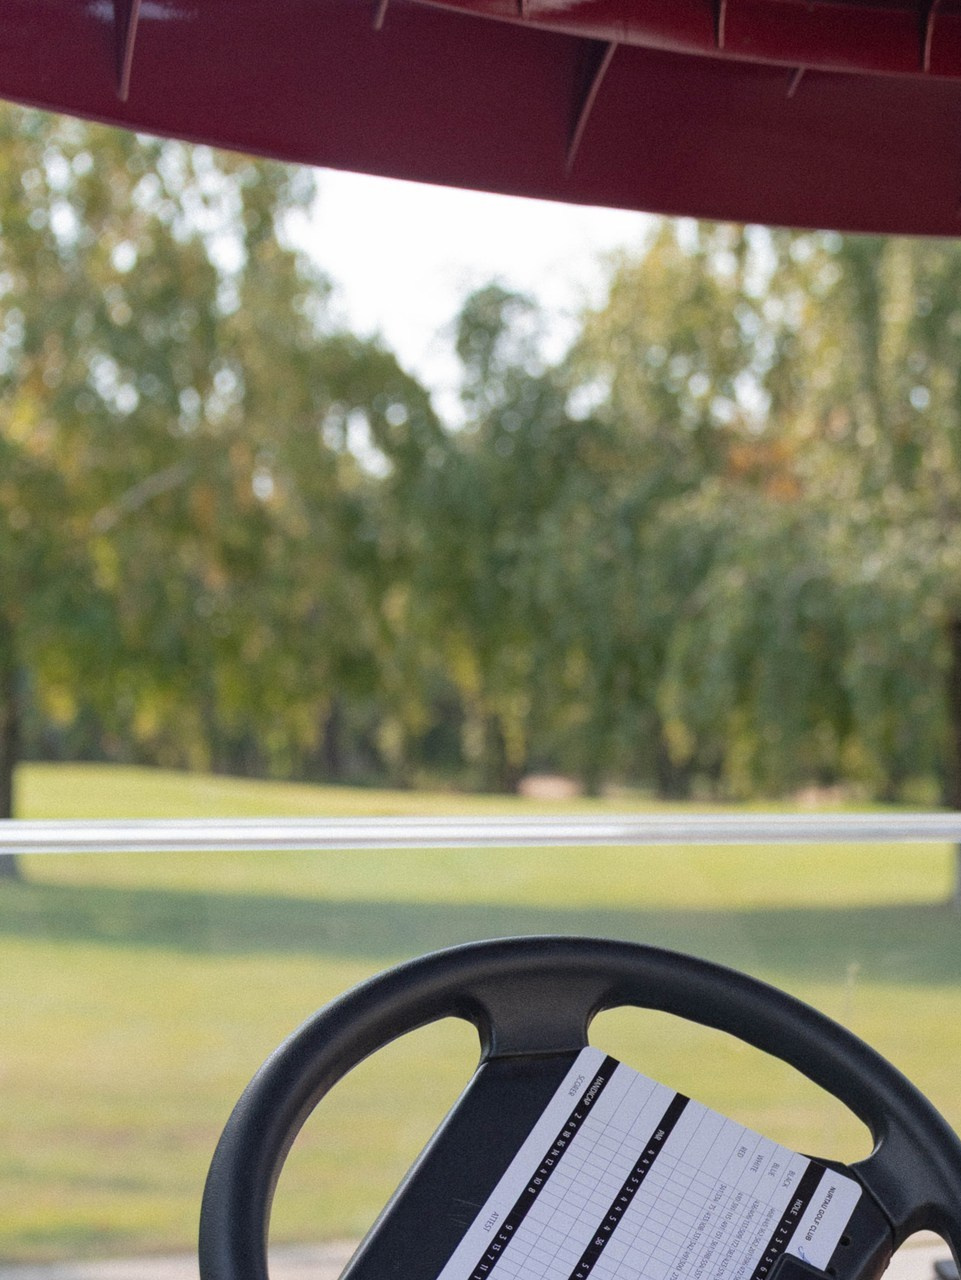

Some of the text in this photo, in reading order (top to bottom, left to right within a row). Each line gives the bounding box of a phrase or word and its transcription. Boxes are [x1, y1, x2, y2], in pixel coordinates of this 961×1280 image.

[567, 1074, 585, 1097] SCORER
[582, 1075, 604, 1105] HANDICAP
[561, 1129, 571, 1138] 18
[653, 1129, 664, 1141] PAR
[556, 1139, 565, 1147] 16
[550, 1148, 559, 1156] 14
[736, 1145, 747, 1158] RED
[544, 1157, 553, 1165] 12
[750, 1153, 764, 1173] WHITE
[532, 1176, 542, 1185] 10
[820, 1185, 836, 1209] NURTAU
[789, 1198, 803, 1215] HOLE
[481, 1210, 499, 1232] ATTEST
[812, 1208, 825, 1225] GOLF
[804, 1224, 817, 1241] CLUB
[491, 1242, 501, 1251] 13
[593, 1236, 604, 1246] 36
[479, 1263, 488, 1271] 11
[759, 1265, 767, 1273] 6
